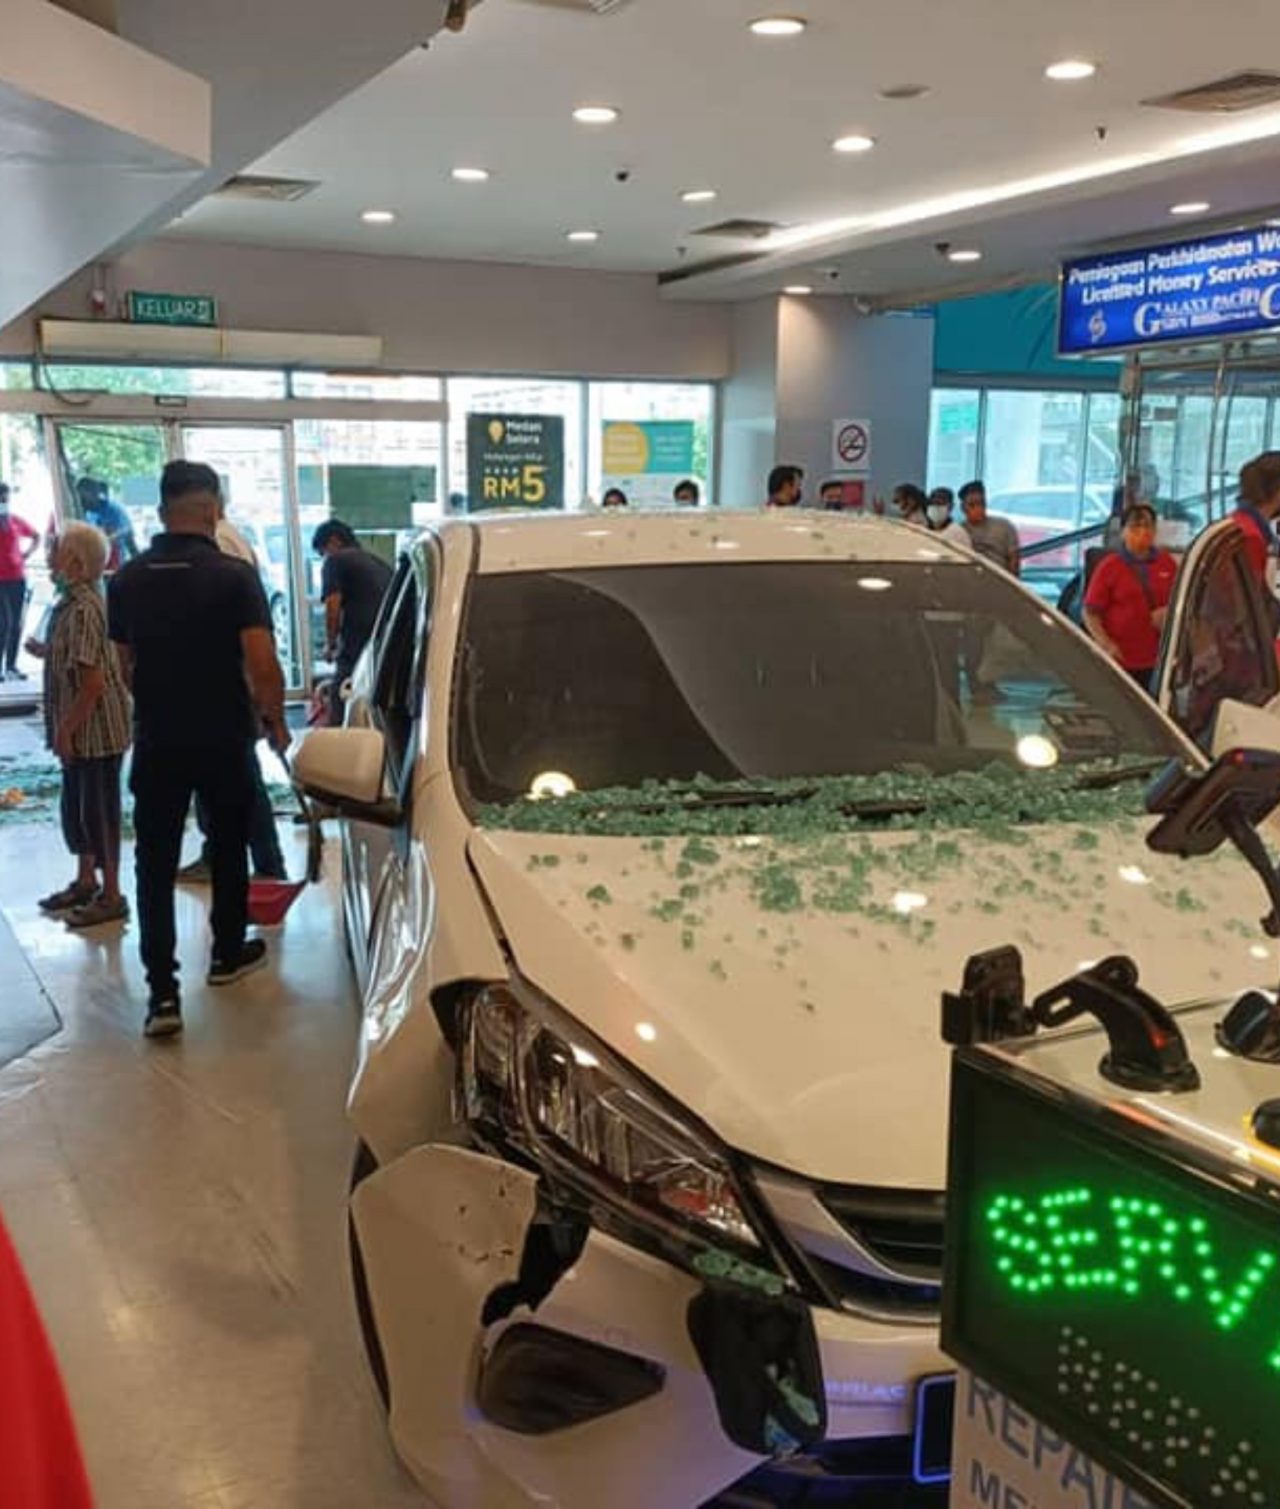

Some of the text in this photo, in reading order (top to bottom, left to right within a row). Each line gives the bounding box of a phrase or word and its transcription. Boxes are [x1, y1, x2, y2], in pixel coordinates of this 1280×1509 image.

[1148, 238, 1253, 272] Perkhidmatan
[1082, 278, 1145, 305] Licensed
[1148, 272, 1204, 295] Money
[1207, 259, 1277, 286] Services
[138, 299, 196, 319] KELUAR
[484, 465, 546, 502] RM5
[967, 1374, 1158, 1509] REPAI
